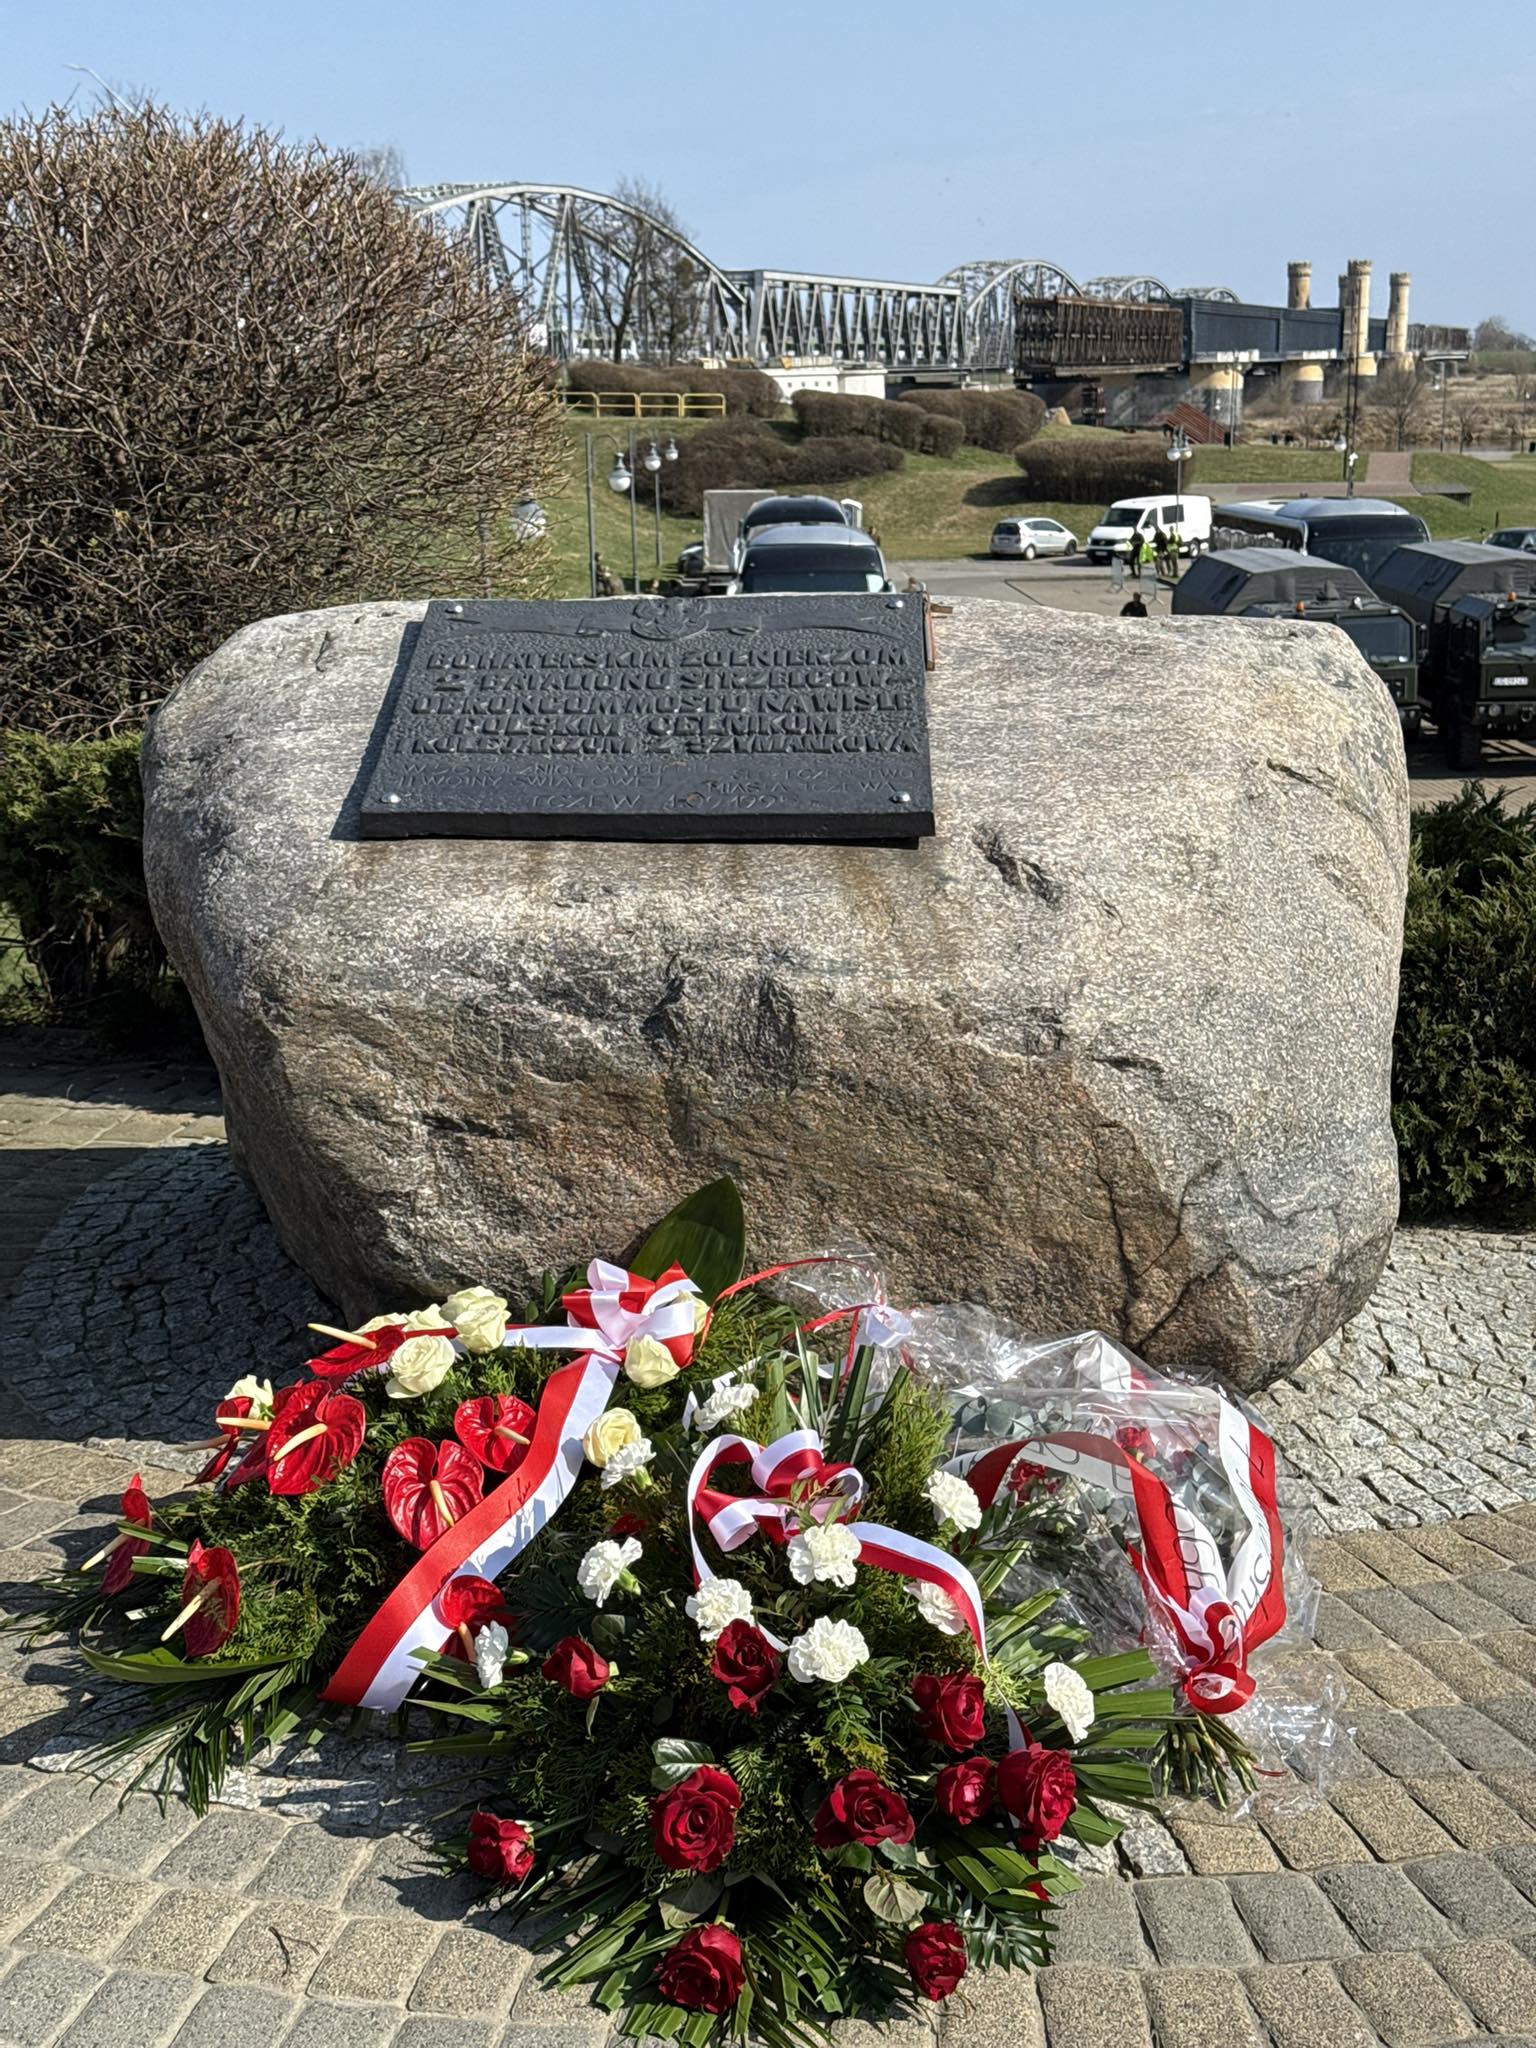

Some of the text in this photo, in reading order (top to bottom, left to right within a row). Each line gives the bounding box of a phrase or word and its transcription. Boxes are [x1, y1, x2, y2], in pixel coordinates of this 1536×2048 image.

[426, 651, 672, 669] BOHATERSKIM
[479, 669, 672, 691] BATALIONU
[622, 693, 748, 713] MOSTU
[756, 692, 806, 712] NA
[455, 713, 839, 736] POLSKIM CELNIKOM
[412, 735, 642, 754] KOLEJARZOM
[685, 733, 921, 754] SZYMANKOWA
[403, 762, 426, 776] W
